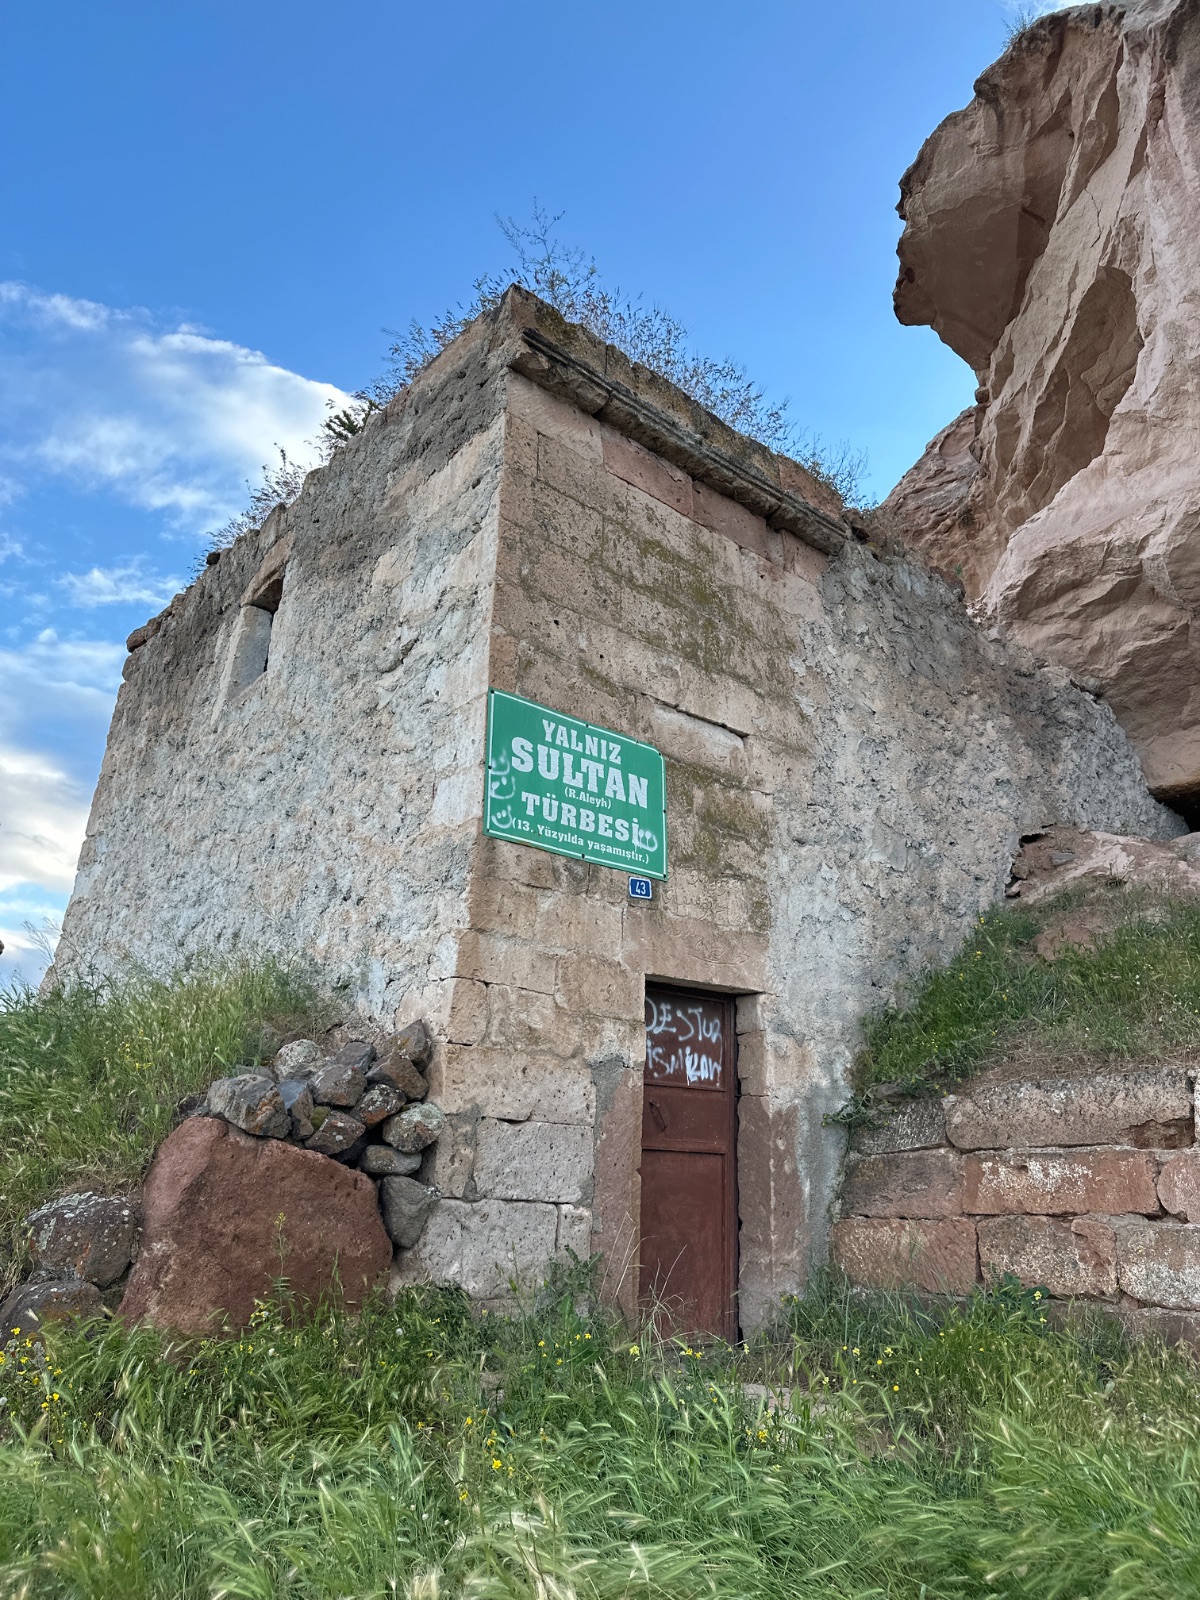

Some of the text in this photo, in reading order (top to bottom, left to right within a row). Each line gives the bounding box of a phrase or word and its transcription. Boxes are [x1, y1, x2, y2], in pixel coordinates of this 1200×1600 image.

[542, 719, 621, 765] YALNIZ
[511, 736, 649, 809] SULTAN
[521, 791, 640, 845] TÜRBESİ
[564, 786, 612, 810] (R.Aleyh)
[512, 816, 649, 865] (13. Yüzyılda yaşamıştır.)
[635, 881, 646, 895] 43
